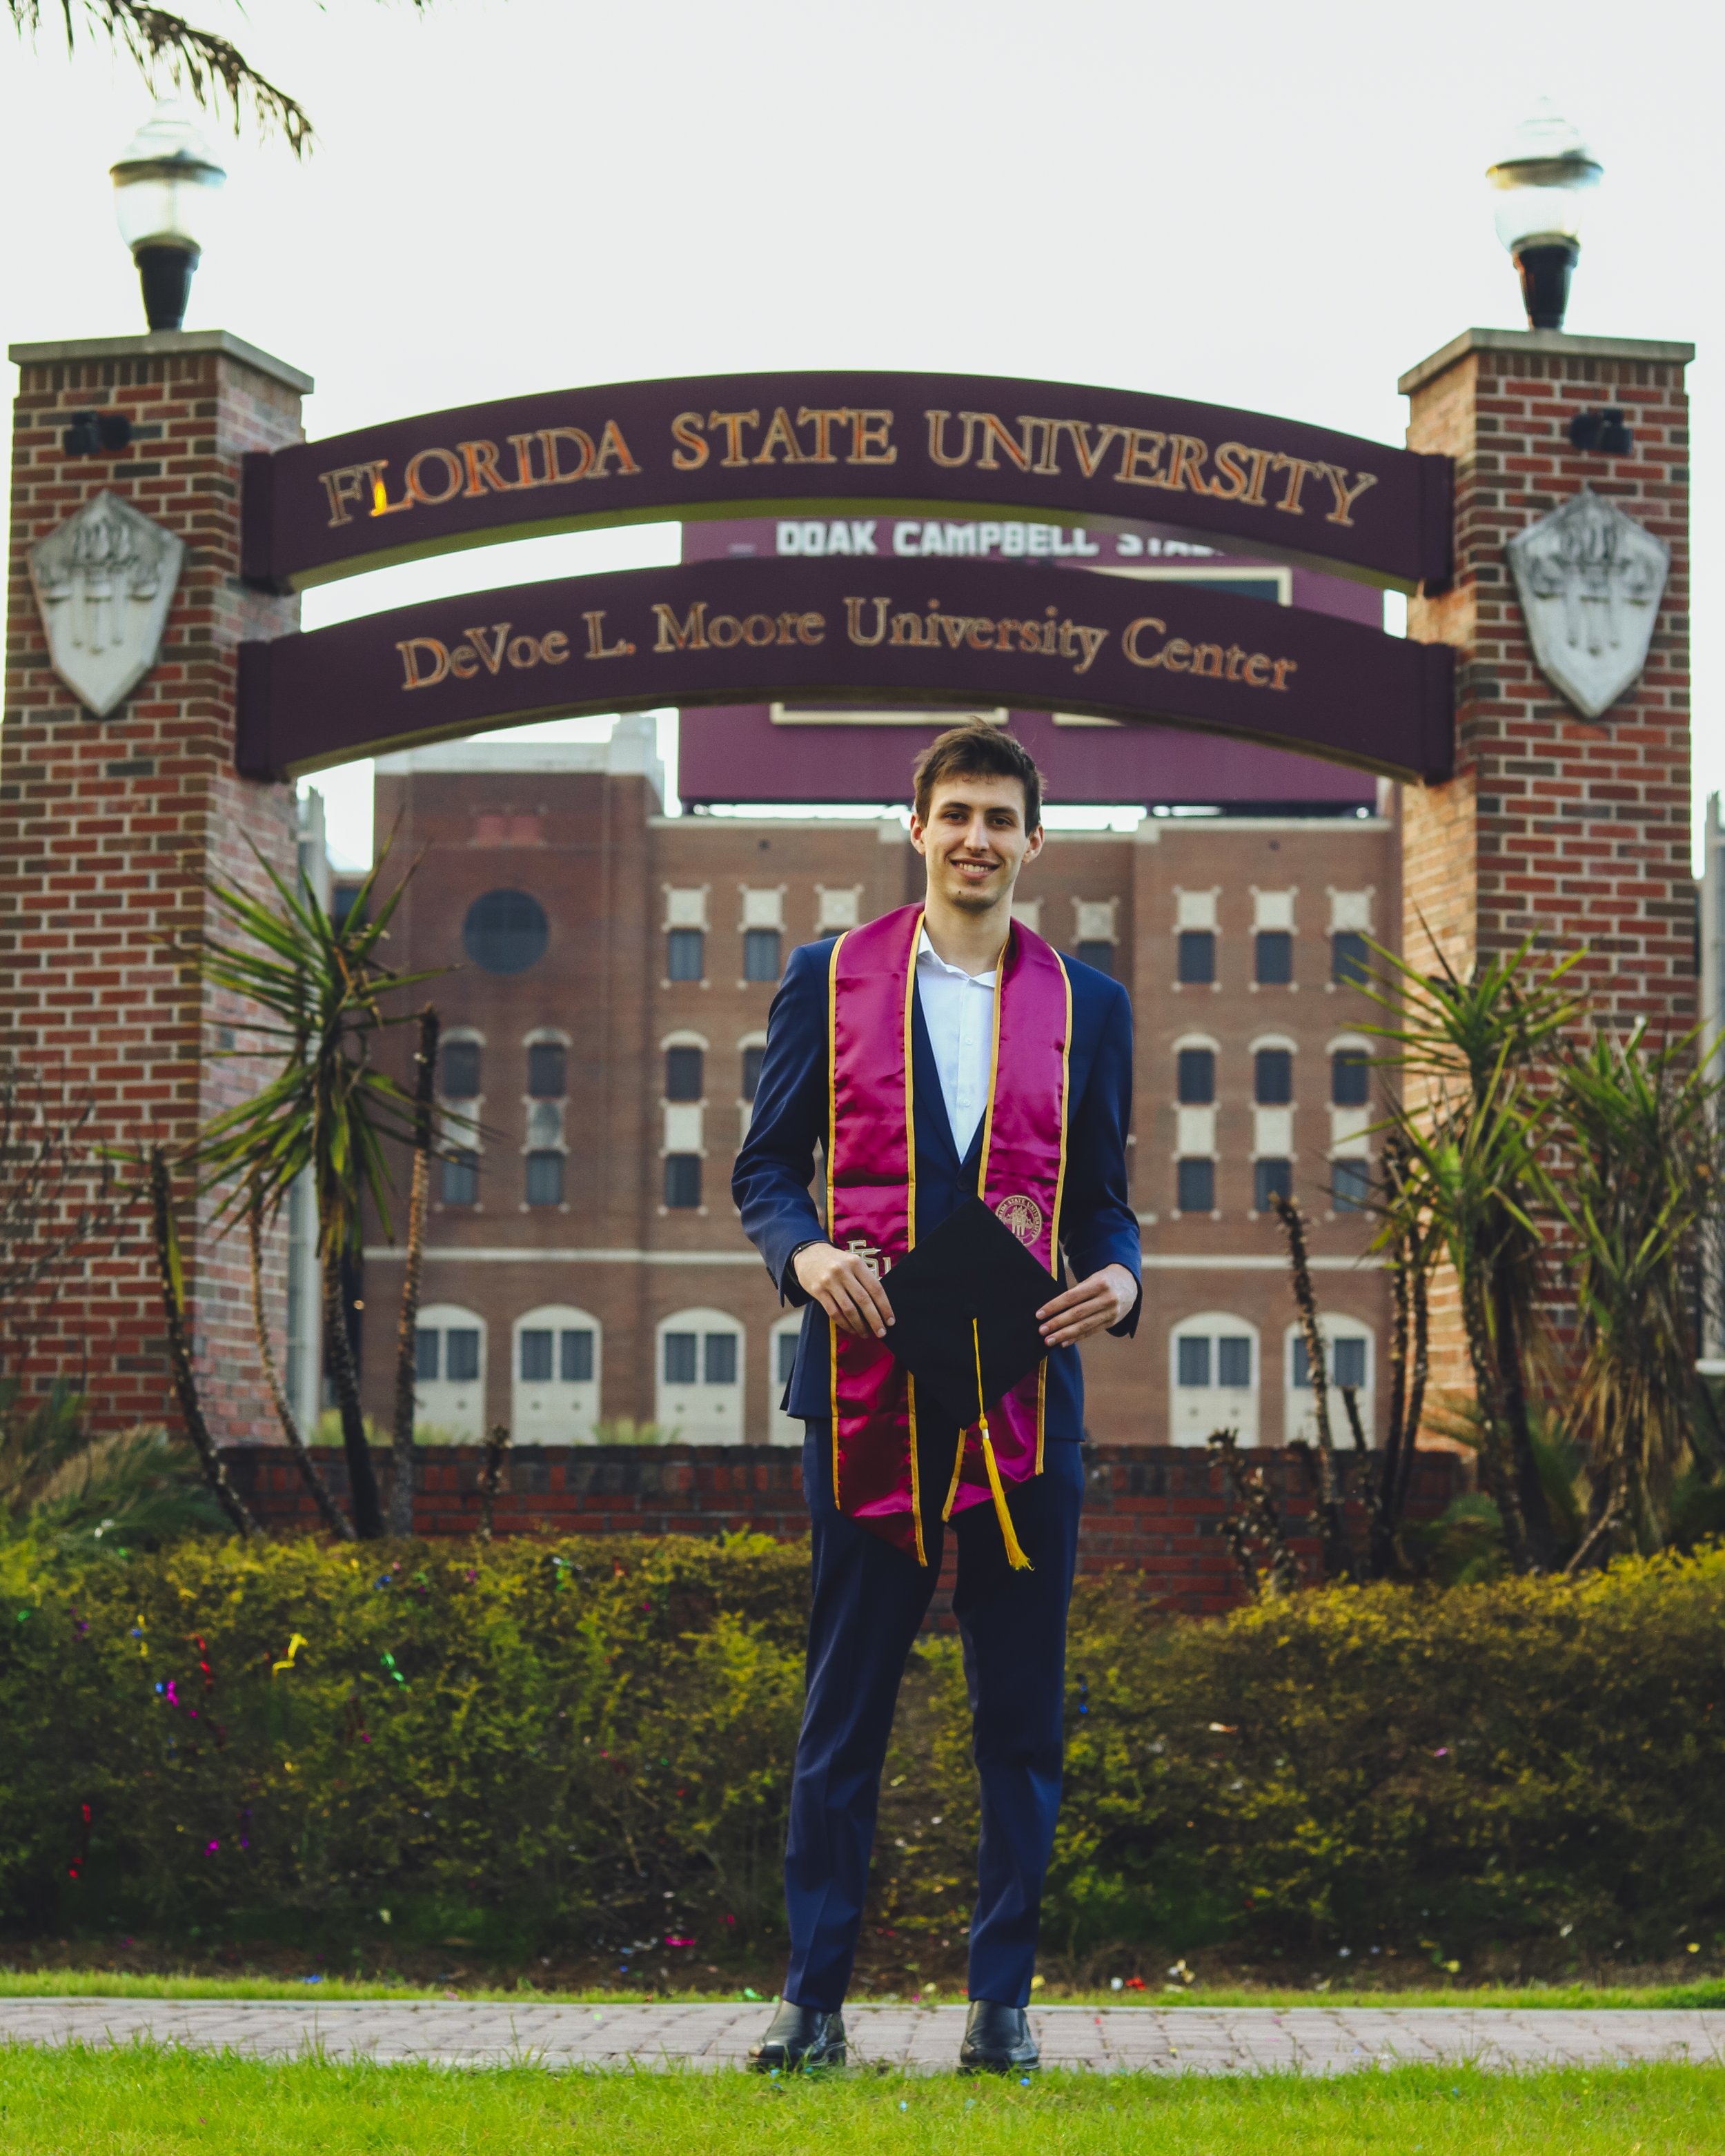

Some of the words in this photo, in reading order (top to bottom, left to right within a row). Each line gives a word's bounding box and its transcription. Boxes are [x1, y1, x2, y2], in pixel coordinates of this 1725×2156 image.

[319, 419, 641, 528] FLORIDA
[671, 406, 898, 471] STATE
[925, 409, 1377, 526] UNIVERSITY
[777, 521, 877, 555] DOAK
[893, 521, 1099, 557] CAMPBELL
[395, 623, 570, 690] DeVoe
[583, 611, 636, 660] L.
[652, 602, 825, 653] Moore
[843, 597, 1109, 673] University
[1122, 617, 1297, 691] Center
